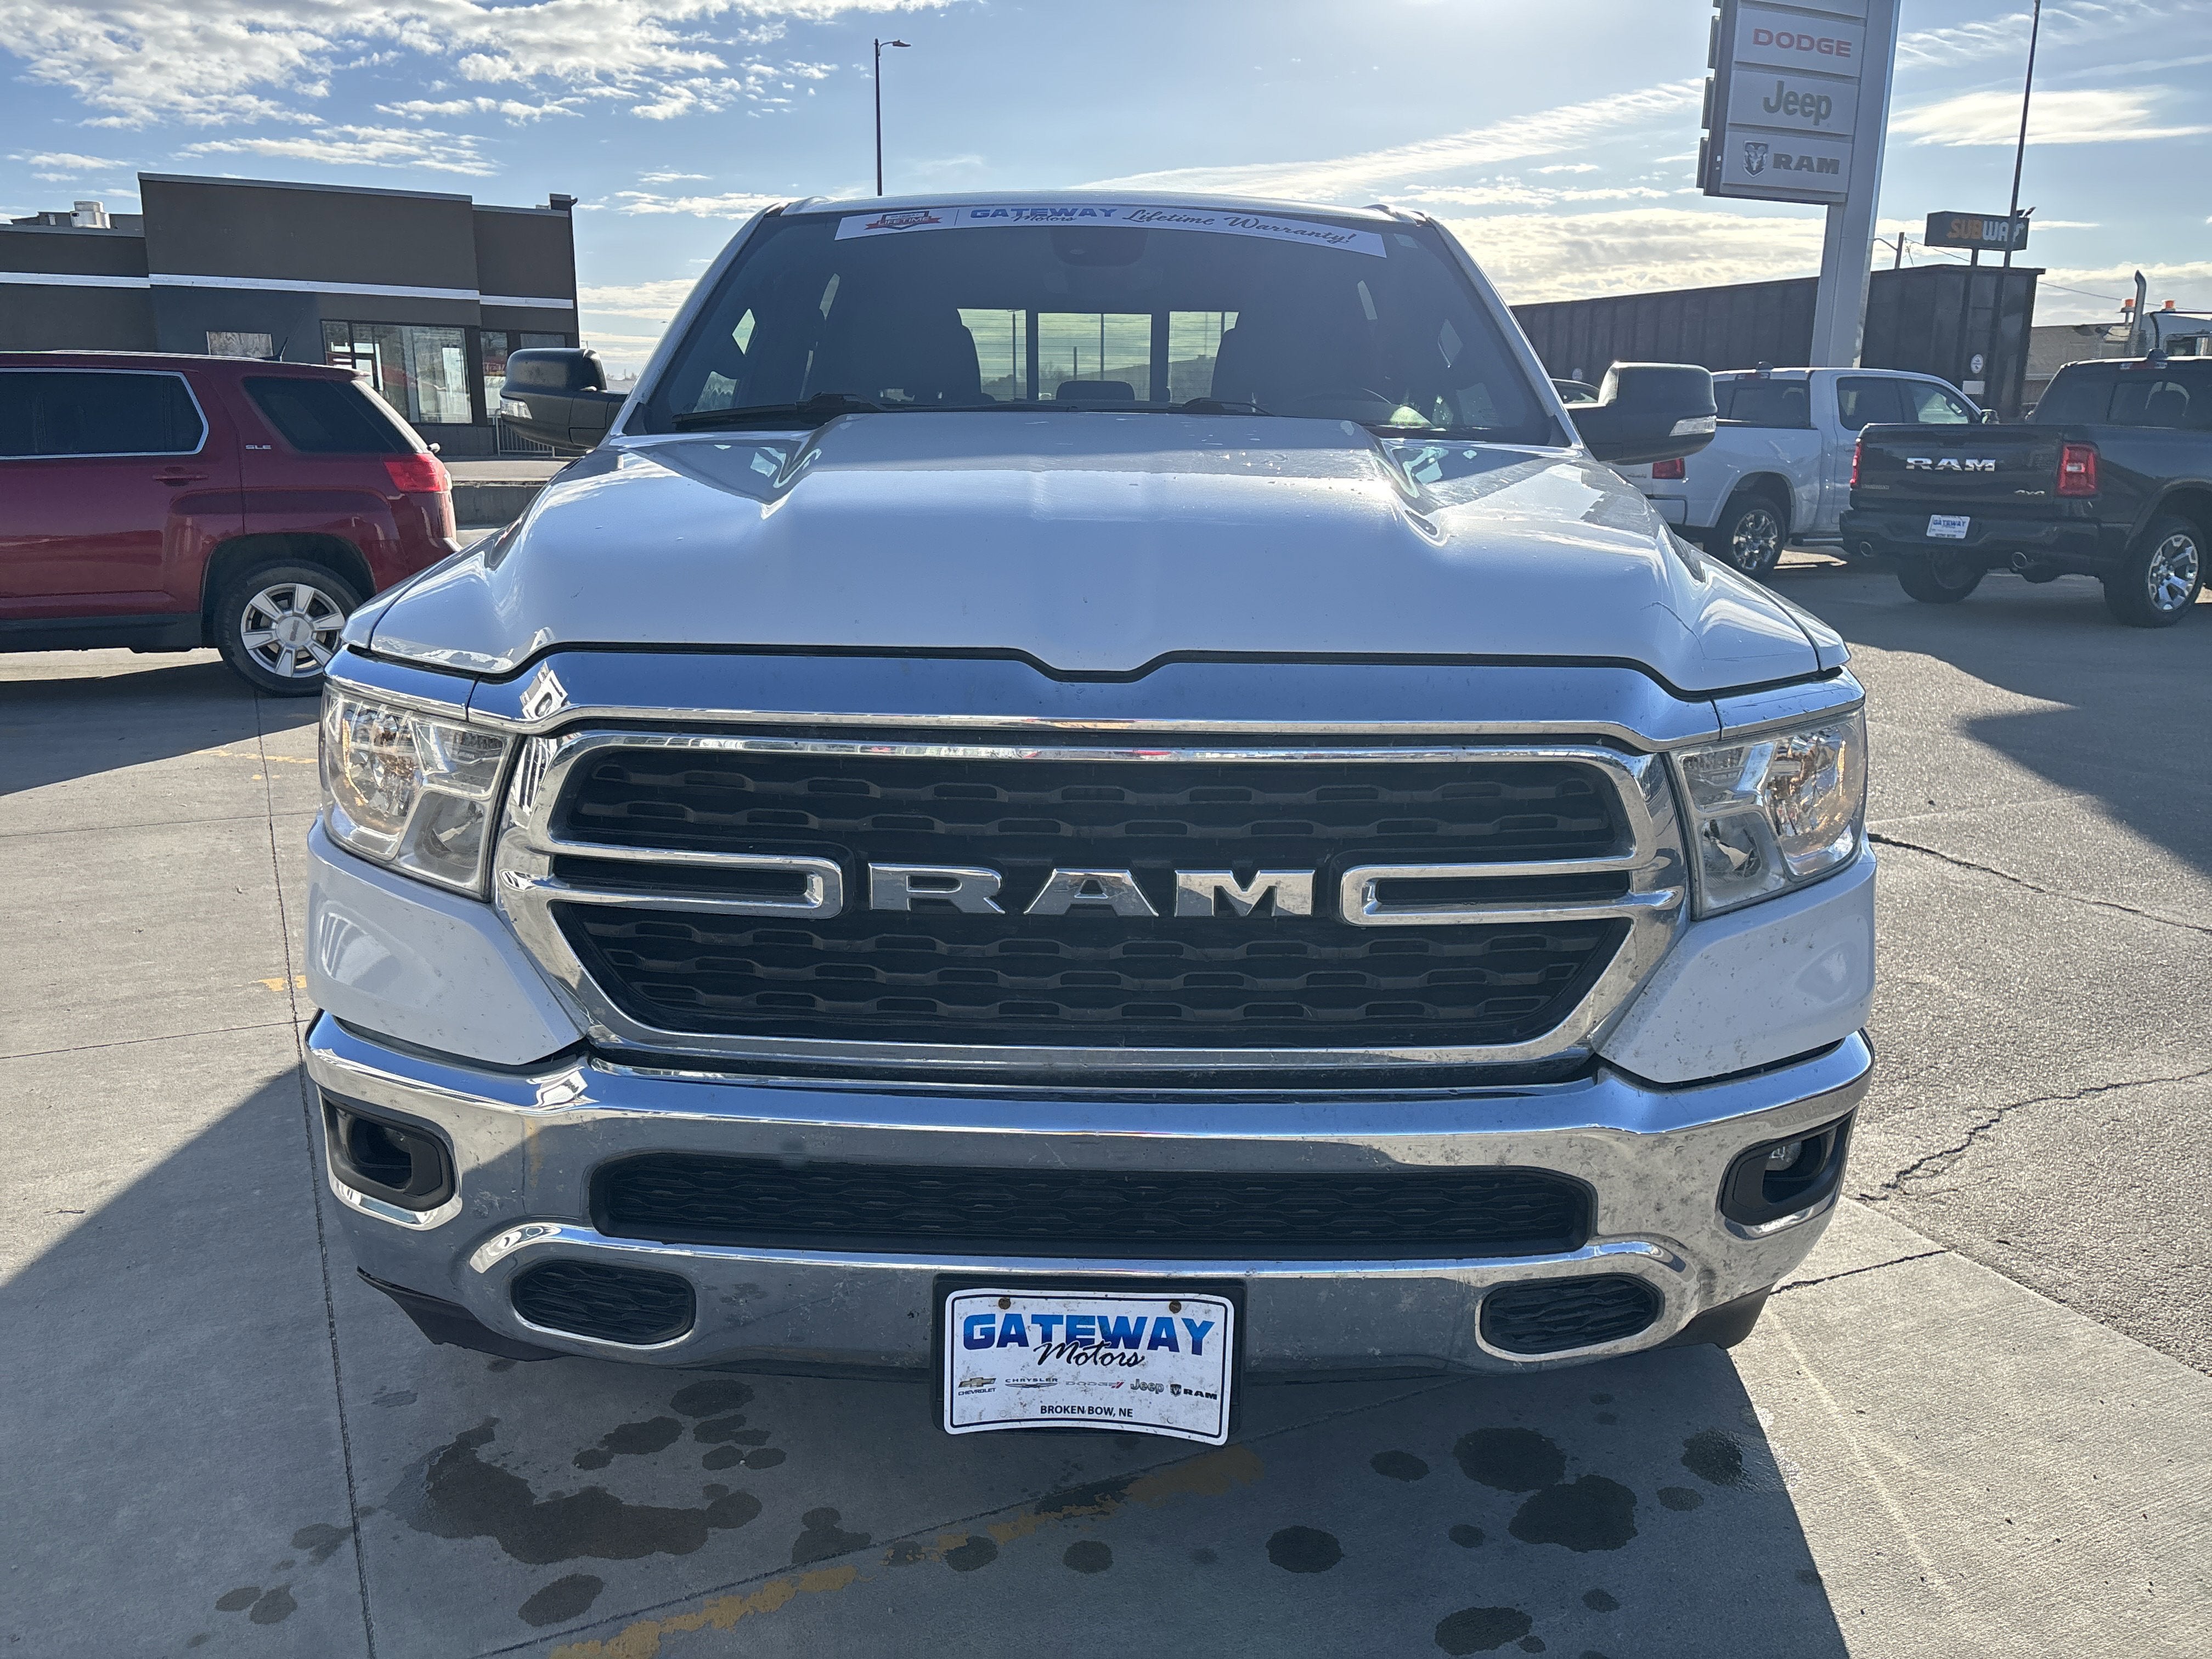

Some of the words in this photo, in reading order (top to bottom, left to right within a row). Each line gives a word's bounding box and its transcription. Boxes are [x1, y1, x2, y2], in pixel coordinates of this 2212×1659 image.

[1752, 28, 1852, 58] DODGE
[1762, 80, 1832, 126] Jeep
[1772, 153, 1840, 175] RAM
[970, 208, 1118, 218] GATEWAY
[1122, 209, 1216, 225] Lifetime
[1223, 217, 1357, 244] Warranty!
[1905, 458, 1996, 472] RAM
[868, 862, 1316, 917] RAM
[963, 1313, 1216, 1356] GATEWAY
[1033, 1340, 1146, 1368] Motors
[958, 1387, 997, 1396] CHEVROLET
[1130, 1379, 1165, 1395] Jeep
[1183, 1388, 1217, 1400] RAM
[1040, 1405, 1085, 1414] BROKEN
[1087, 1406, 1116, 1417] BOW,
[1119, 1408, 1133, 1418] NE
